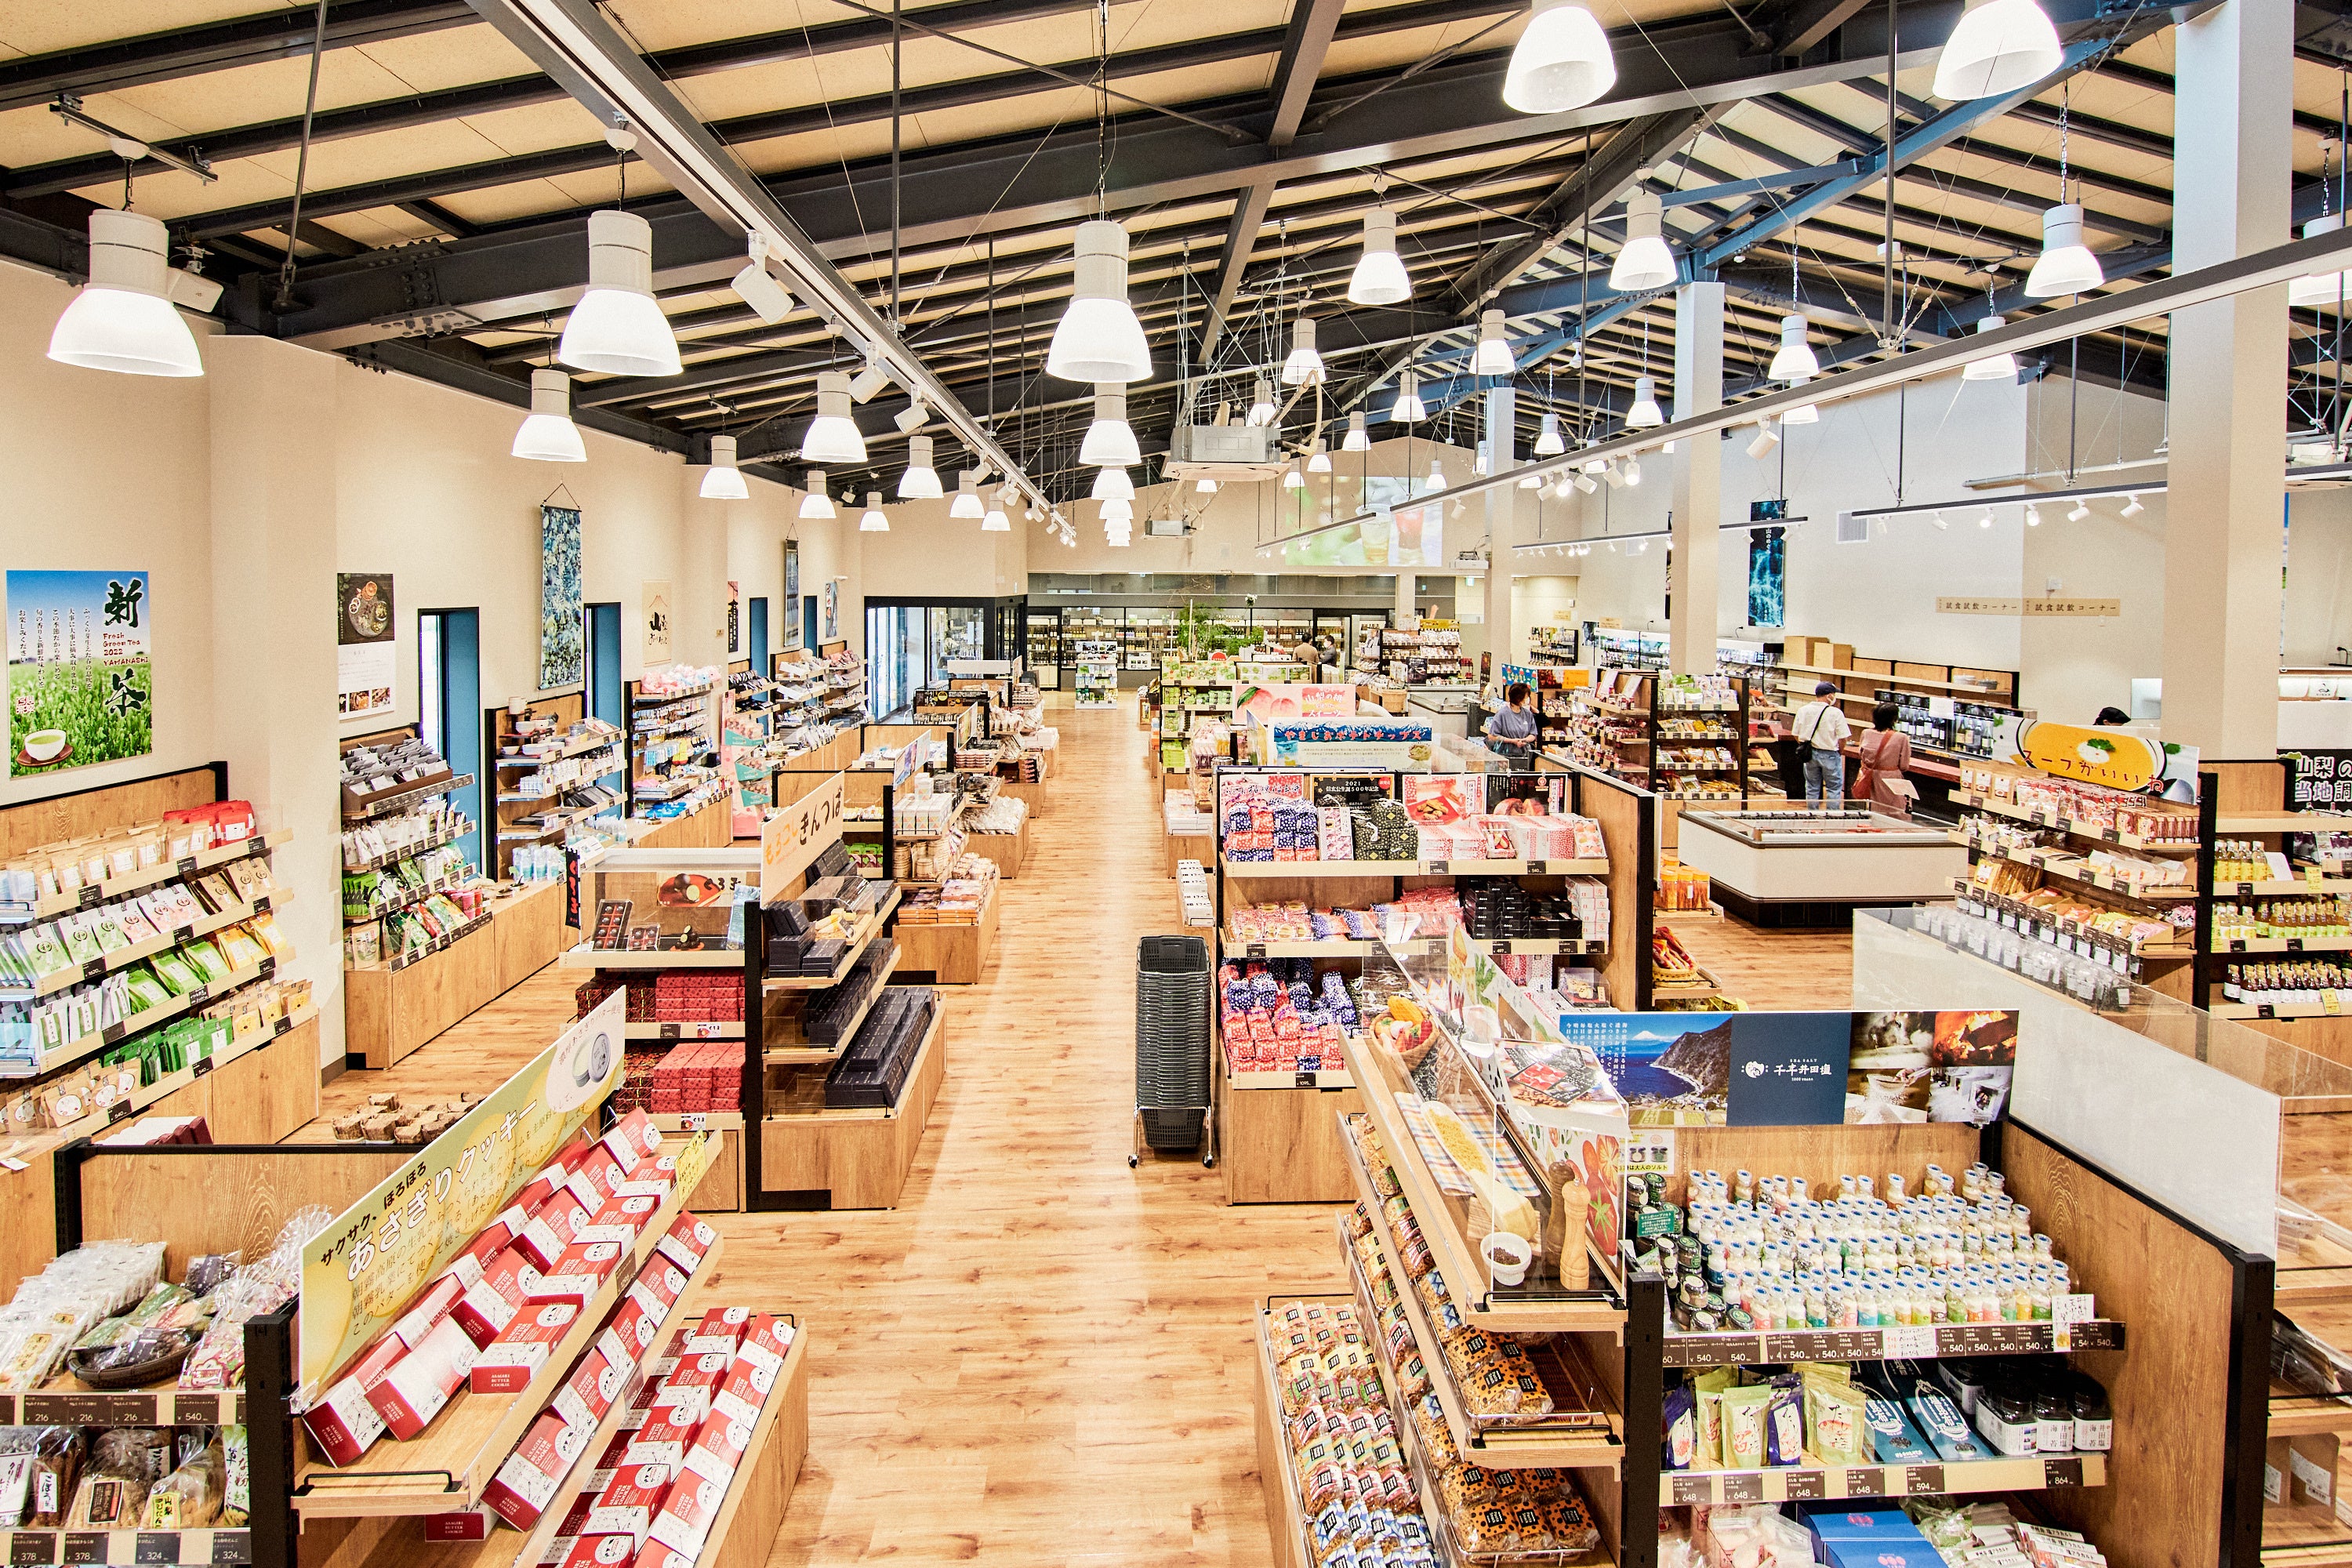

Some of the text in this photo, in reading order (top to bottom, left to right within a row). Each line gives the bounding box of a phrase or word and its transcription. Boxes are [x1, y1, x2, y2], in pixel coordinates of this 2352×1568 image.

[104, 579, 143, 628] 新
[103, 657, 148, 666] YAMANASHI
[105, 668, 147, 717] 茶
[1285, 730, 1425, 741] やましおポテトチップス
[2023, 750, 2164, 793] スープがいいね
[348, 1099, 537, 1281] あさぎりクッキー
[492, 1269, 508, 1287] ASAGIRI
[495, 1273, 512, 1290] BUTTER
[499, 1276, 514, 1294] COOKIE
[576, 1371, 590, 1392] ASAGIRI
[579, 1375, 593, 1396] BUTTER
[583, 1379, 597, 1399] COOKIE
[527, 1436, 544, 1459] ASAGIRI
[530, 1440, 548, 1463] BUTTER
[535, 1443, 552, 1465] COOKIE
[618, 1484, 632, 1505] COOKIE
[673, 1493, 686, 1514] ASAGIRI
[677, 1495, 691, 1518] BUTTER
[681, 1498, 695, 1519] COOKIE
